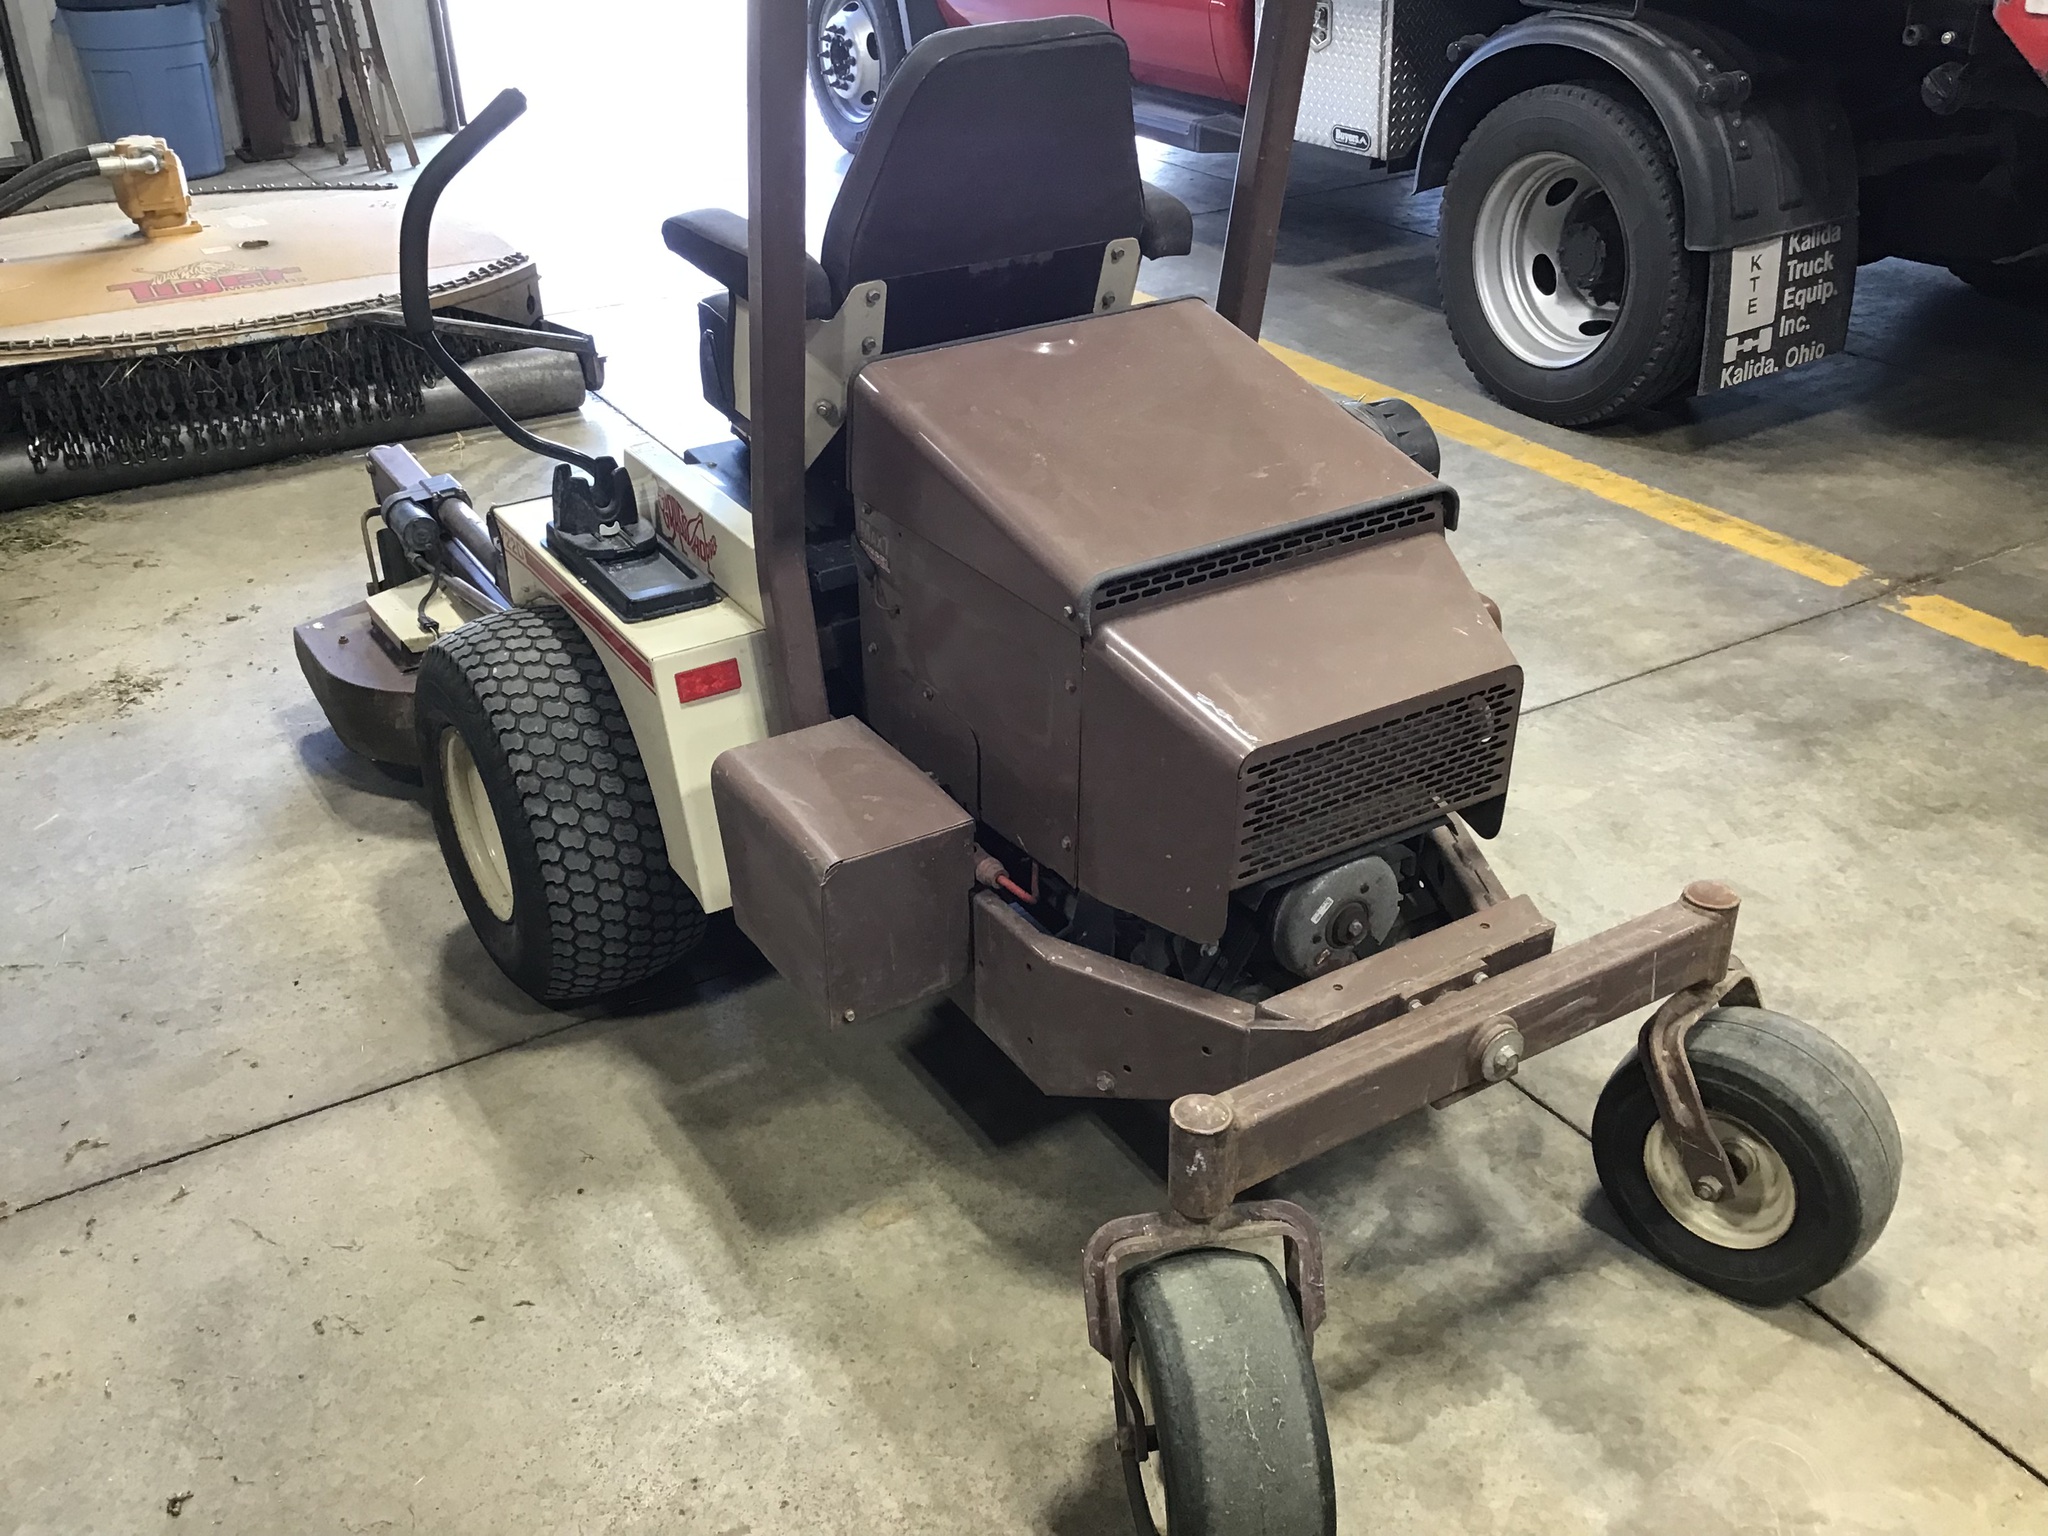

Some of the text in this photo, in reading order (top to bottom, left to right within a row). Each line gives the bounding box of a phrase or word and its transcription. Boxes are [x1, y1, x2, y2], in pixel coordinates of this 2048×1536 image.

[1788, 224, 1842, 255] Kalida
[1787, 250, 1835, 282] Truck
[106, 266, 303, 304] Tiger
[1783, 278, 1838, 311] Equip.
[1779, 315, 1811, 338] Inc.
[1785, 341, 1826, 368] Ohio
